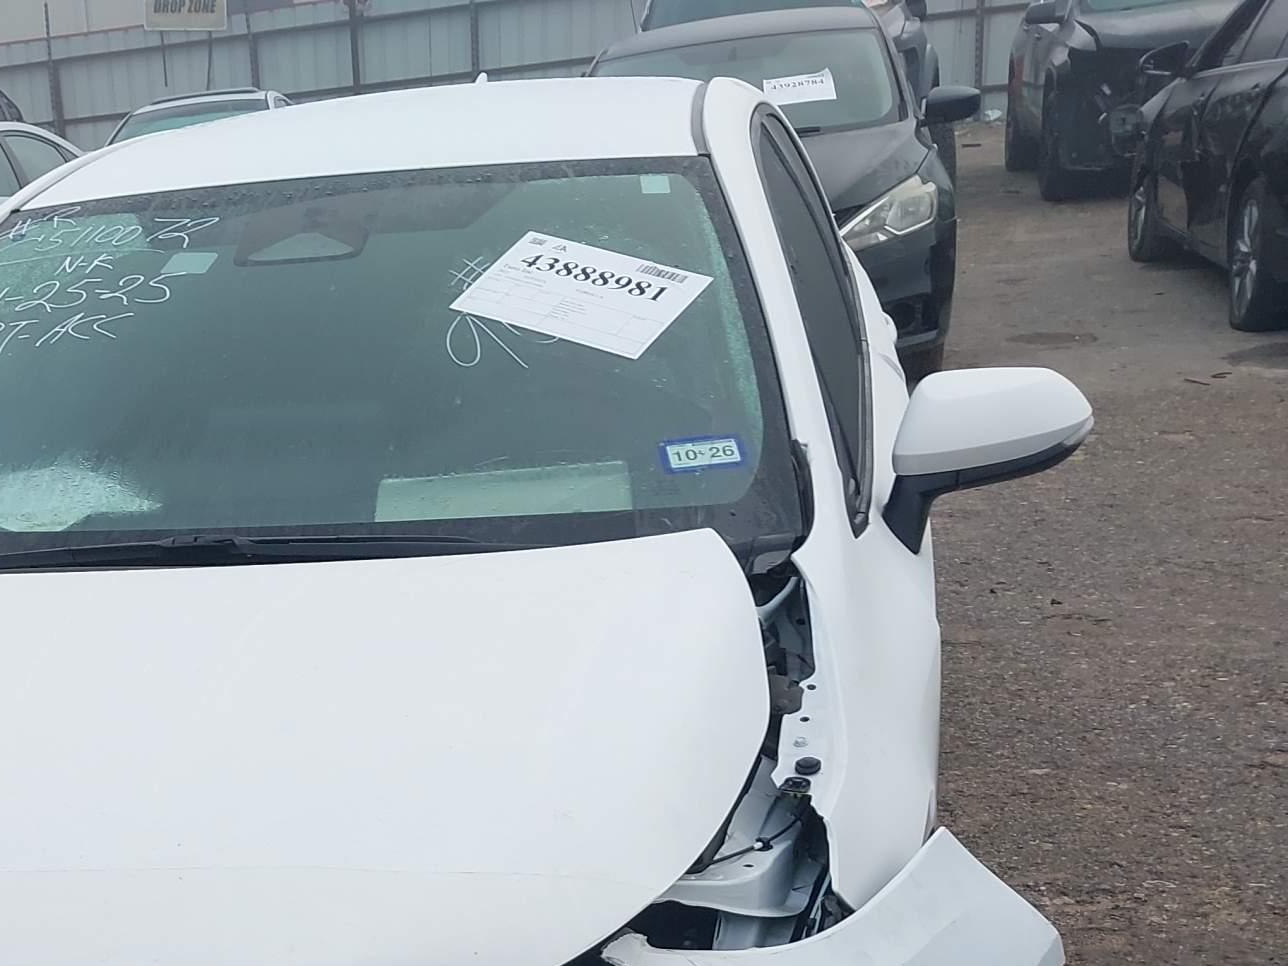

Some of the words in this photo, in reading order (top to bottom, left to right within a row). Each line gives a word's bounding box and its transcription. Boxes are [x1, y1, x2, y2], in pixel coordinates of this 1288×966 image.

[153, 0, 185, 14] DROP
[187, 0, 216, 14] ZONE
[520, 254, 669, 302] 43888981
